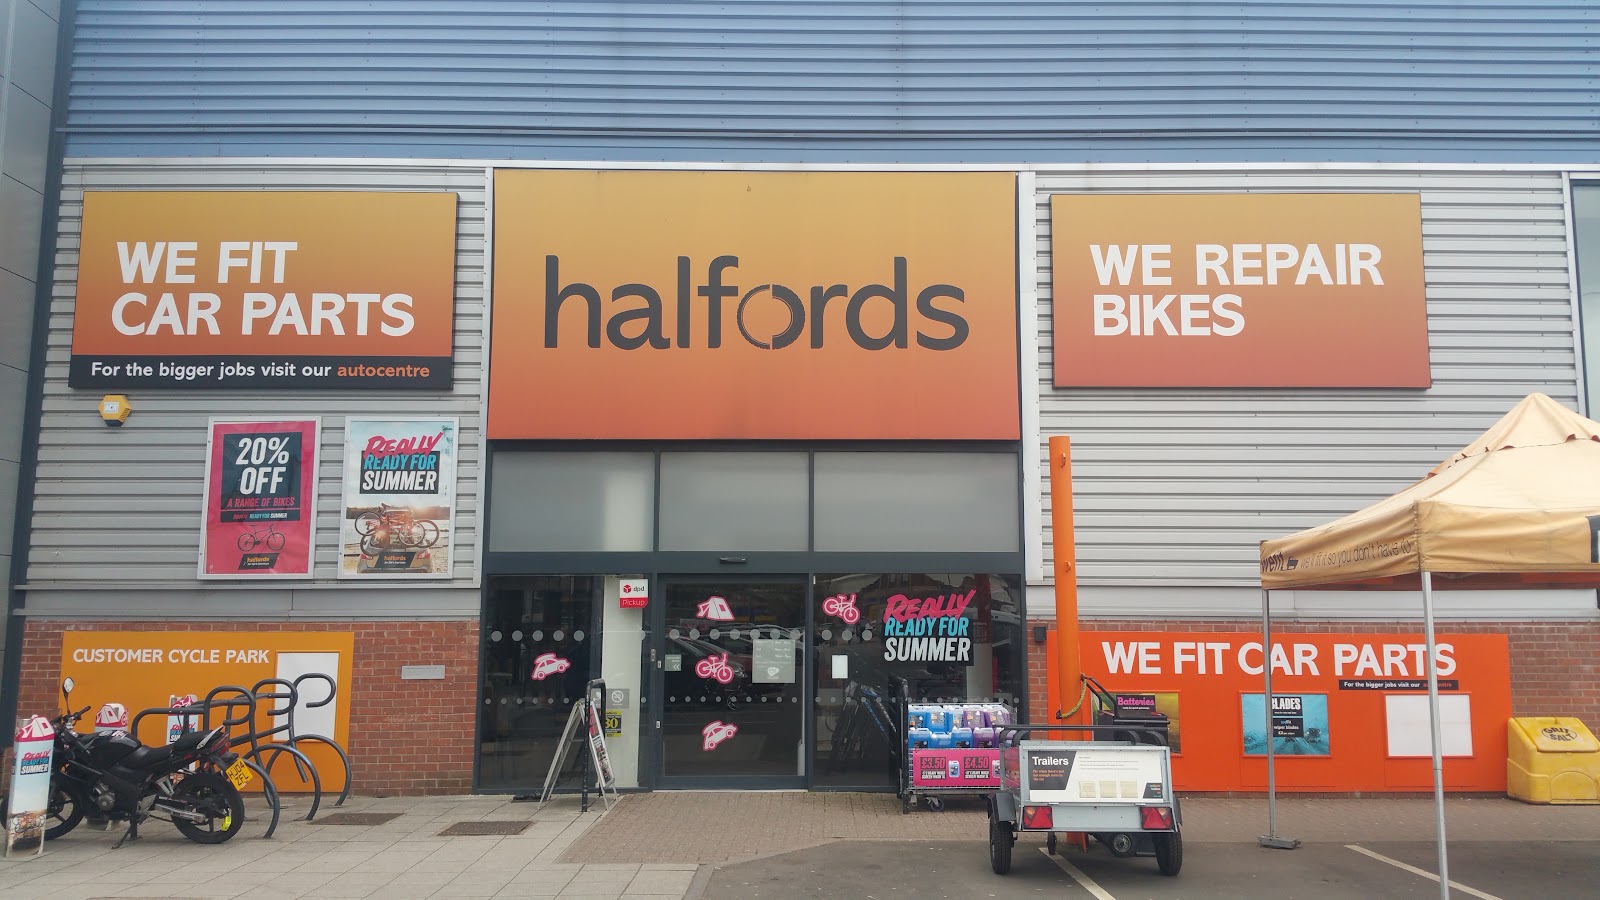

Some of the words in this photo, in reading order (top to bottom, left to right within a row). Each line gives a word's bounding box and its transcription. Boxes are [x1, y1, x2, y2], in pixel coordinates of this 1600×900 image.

[117, 241, 198, 284] WE
[217, 241, 298, 284] FIT
[1089, 244, 1172, 285] WE
[1196, 244, 1384, 285] REPAIR
[544, 254, 970, 351] halfords
[111, 292, 222, 336] CAR
[241, 293, 415, 337] PARTS
[1093, 294, 1245, 336] BIKES
[91, 362, 120, 376] For
[126, 362, 153, 376] the
[159, 362, 214, 380] bigger
[218, 362, 255, 380] jobs
[261, 362, 296, 377] visit
[302, 365, 332, 377] our
[337, 364, 430, 377] autocentre
[236, 437, 289, 465] 20%
[363, 432, 444, 459] REALLY
[364, 454, 409, 469] READY
[410, 454, 436, 469] FOR
[240, 467, 286, 494] OFF
[363, 471, 437, 490] SUMMER
[227, 499, 233, 507] A
[235, 498, 259, 507] RANGE
[261, 498, 271, 507] OF
[273, 497, 295, 506] BIKES
[1328, 552, 1336, 565] so
[1337, 550, 1351, 568] you
[1354, 543, 1376, 561] don't
[1376, 541, 1399, 557] have
[1401, 538, 1412, 554] to
[883, 589, 976, 623] REALLY
[885, 617, 937, 636] READY
[938, 617, 969, 636] FOR
[73, 648, 163, 663] CUSTOMER
[168, 649, 219, 663] CYCLE
[225, 649, 269, 664] PARK
[884, 637, 971, 661] SUMMER
[1101, 641, 1161, 675] WE
[1173, 642, 1231, 675] FIT
[1238, 643, 1319, 676] CAR
[1333, 644, 1457, 676] PARTS
[1117, 697, 1154, 706] Batteries
[1550, 733, 1575, 741] SALT
[21, 764, 48, 774] SUMMER
[228, 763, 245, 778] HJ04
[922, 758, 946, 769] £3.50
[964, 757, 989, 768] £4.50
[1032, 756, 1069, 766] Trailers
[235, 774, 249, 786] ZFL
